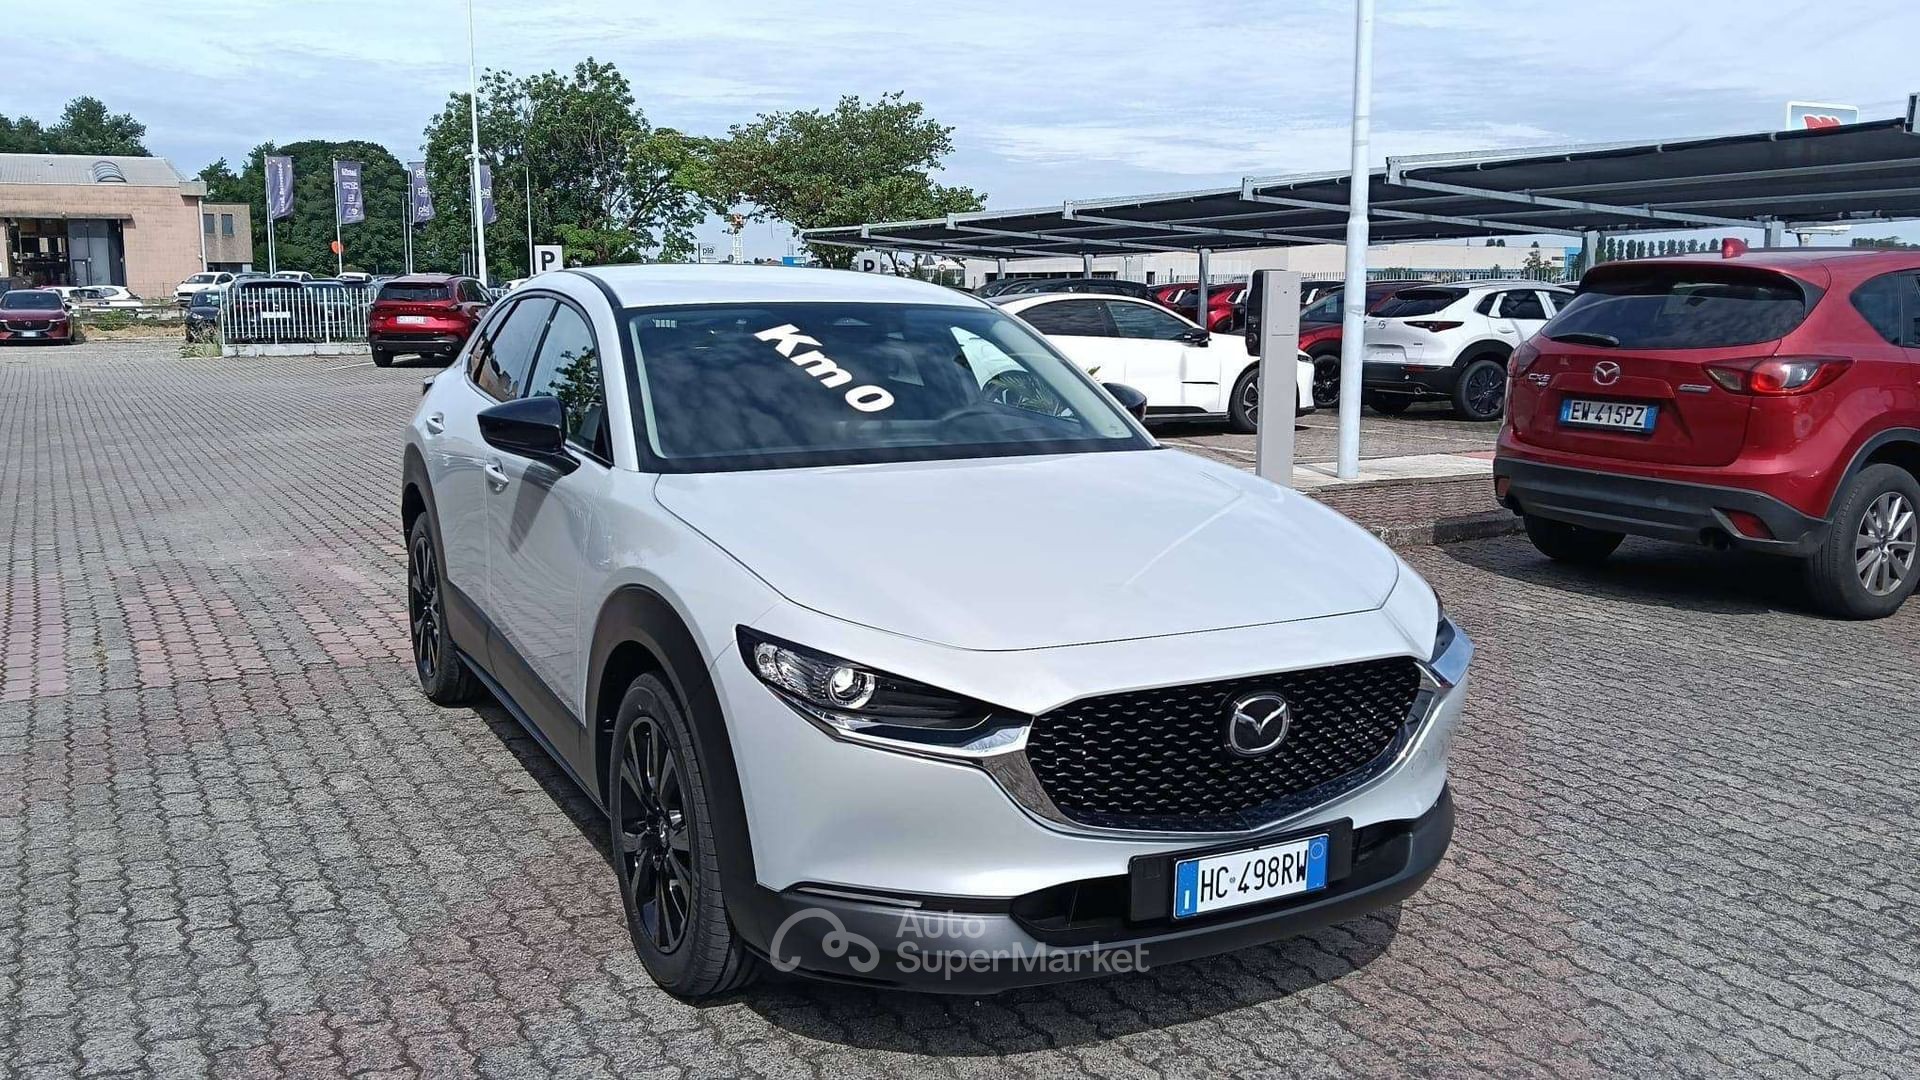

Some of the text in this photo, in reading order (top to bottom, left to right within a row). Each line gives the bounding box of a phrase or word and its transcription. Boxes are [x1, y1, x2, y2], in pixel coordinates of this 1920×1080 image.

[541, 251, 555, 271] P
[753, 323, 853, 388] Km
[1571, 402, 1591, 421] EW
[1595, 404, 1645, 426] 415PZ
[1201, 866, 1229, 903] HC
[1238, 850, 1308, 894] 498RW
